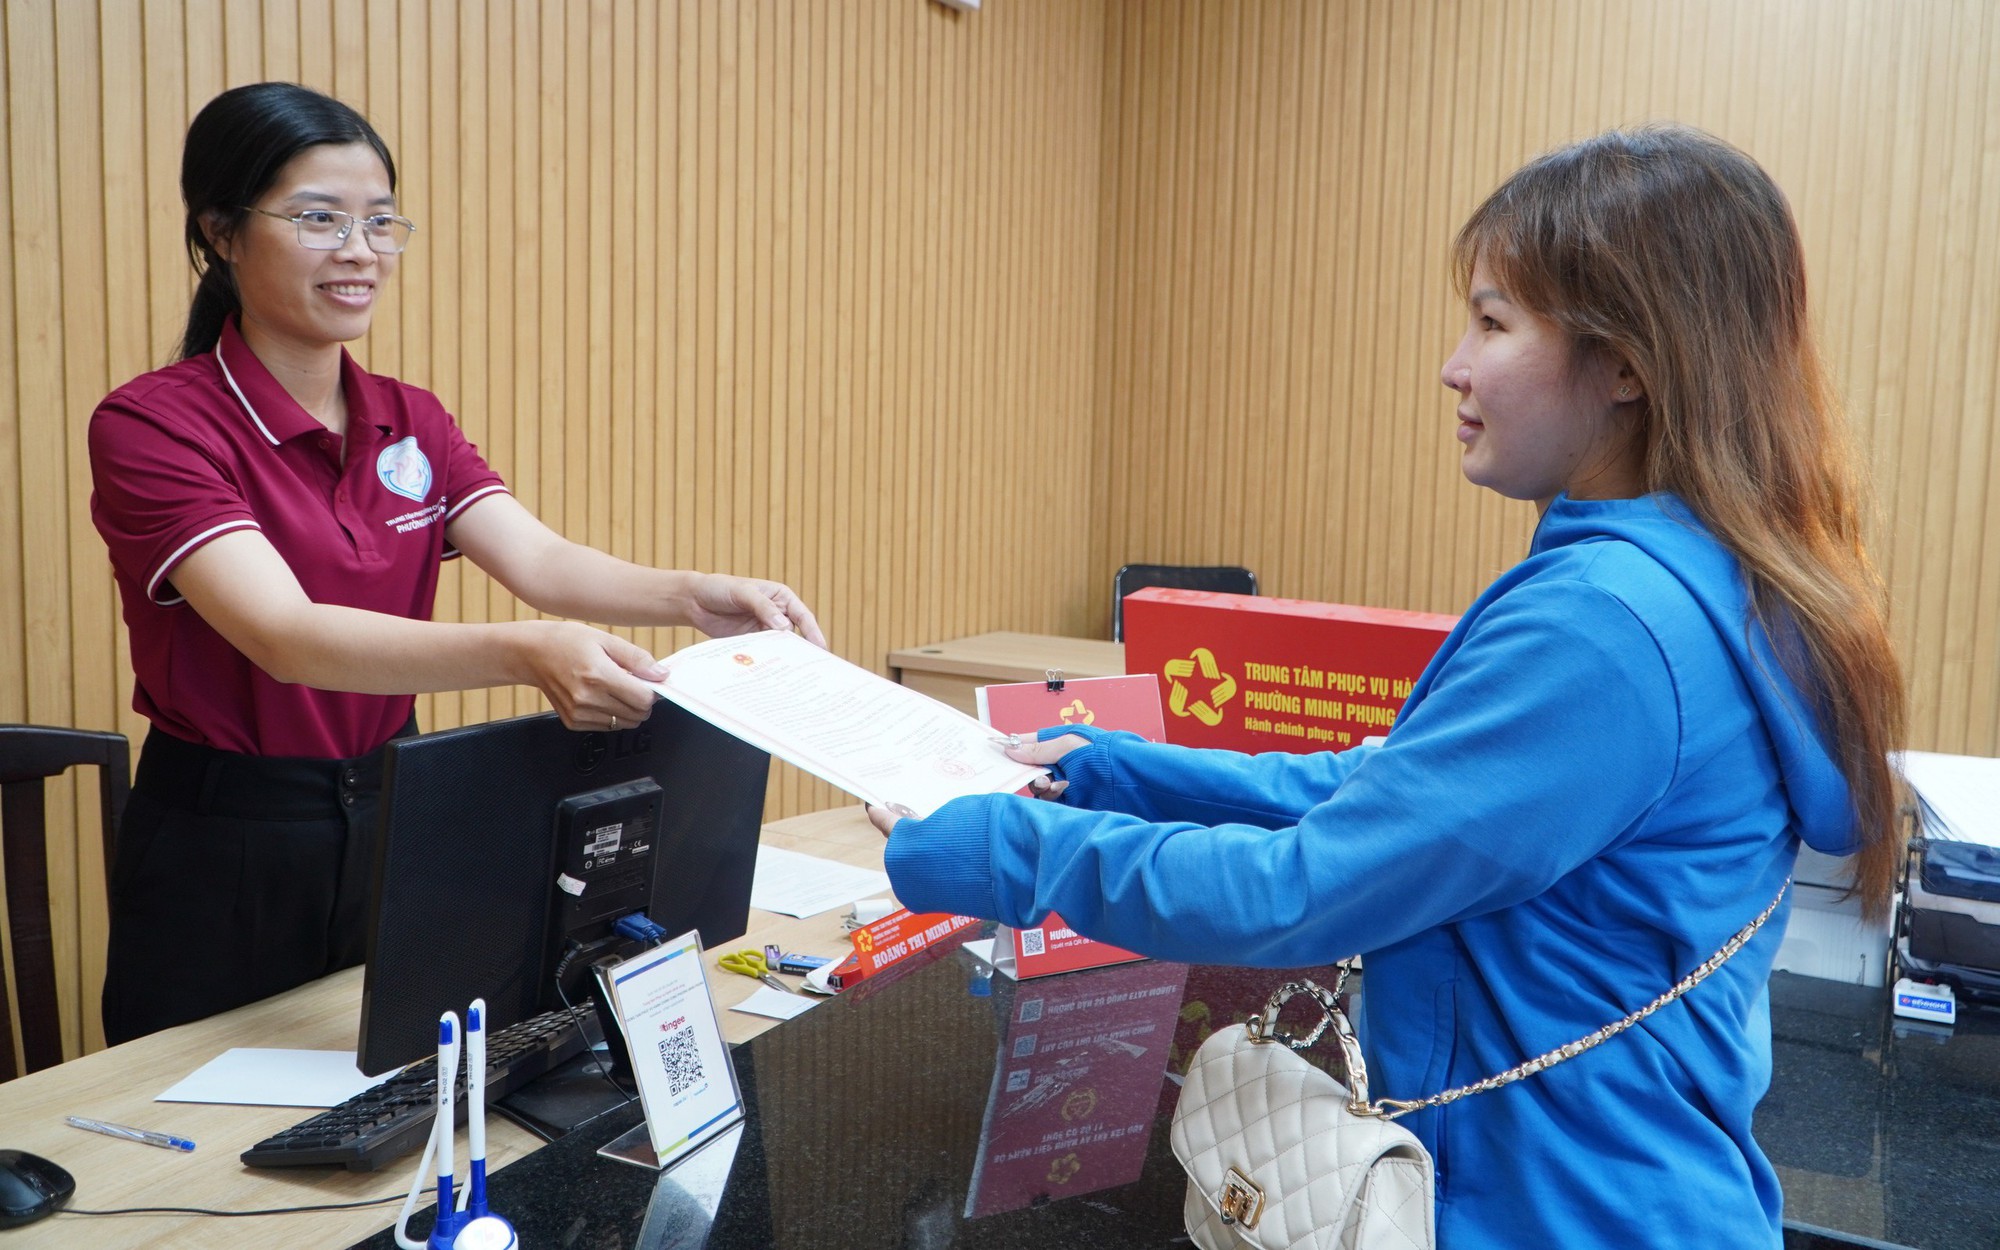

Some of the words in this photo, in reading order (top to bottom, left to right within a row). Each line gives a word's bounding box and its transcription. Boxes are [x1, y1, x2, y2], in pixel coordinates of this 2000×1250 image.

[1244, 662, 1290, 685] TRUNG
[1293, 665, 1324, 688] TÂM
[1327, 672, 1366, 696] PHỤC
[1369, 676, 1389, 700] VỤ
[1392, 677, 1417, 699] HÀ
[1244, 690, 1301, 715] PHƯỜNG
[1304, 698, 1343, 721] MINH
[1346, 703, 1396, 728] PHỤNG
[1244, 717, 1272, 733] Hành
[1274, 722, 1305, 738] chính
[1307, 727, 1334, 744] phục
[1337, 732, 1351, 746] vụ
[872, 941, 907, 969] HOÀNG
[907, 932, 927, 949] THỊ
[924, 919, 952, 942] MINH
[660, 1014, 686, 1032] tingee
